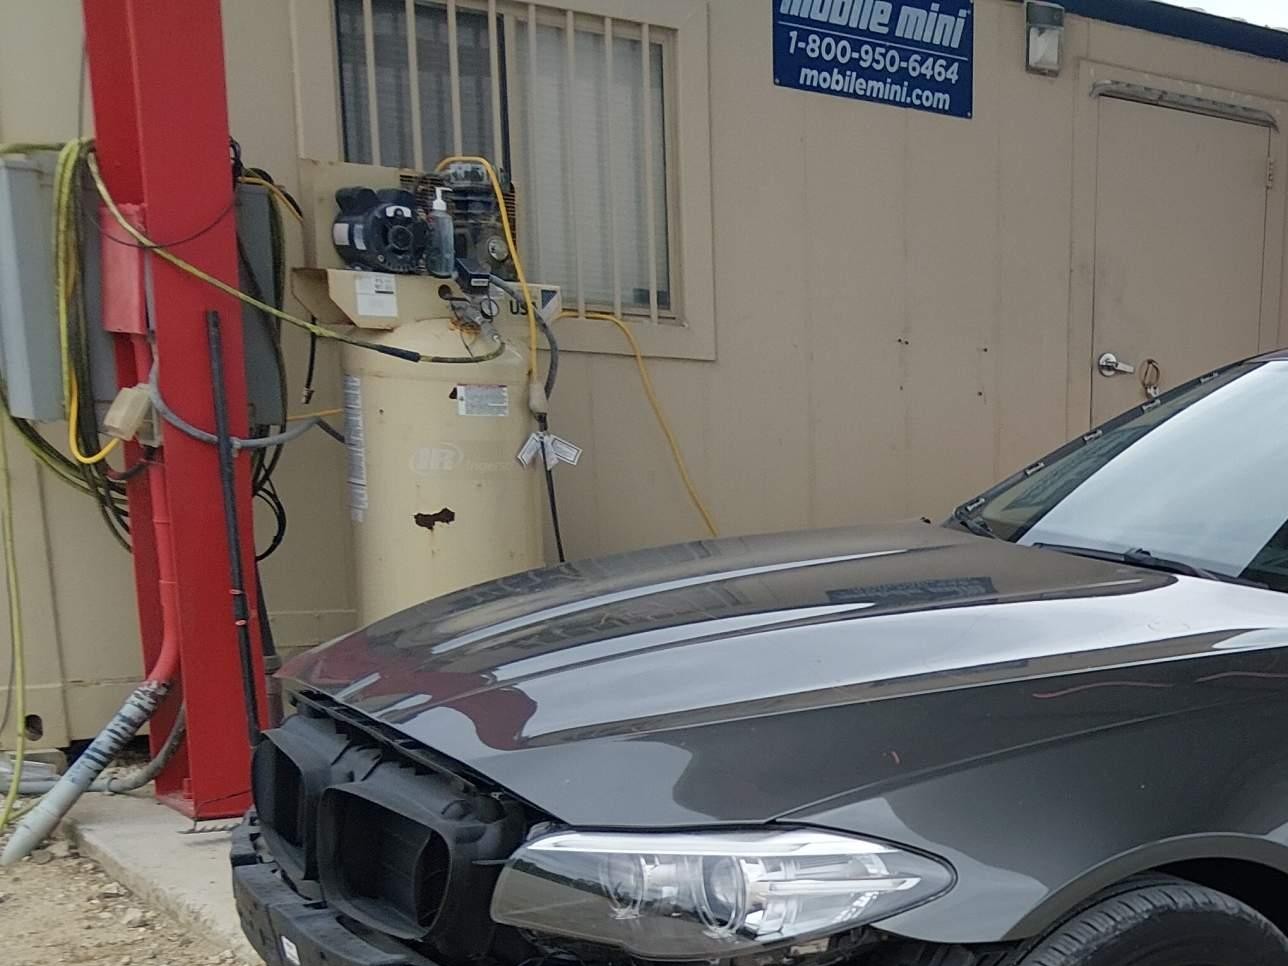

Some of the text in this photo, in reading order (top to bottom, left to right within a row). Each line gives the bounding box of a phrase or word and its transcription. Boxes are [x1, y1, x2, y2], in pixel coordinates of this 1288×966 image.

[895, 3, 967, 48] mini
[788, 31, 959, 84] 1-800-950-6464
[800, 67, 951, 110] mobilemini.com
